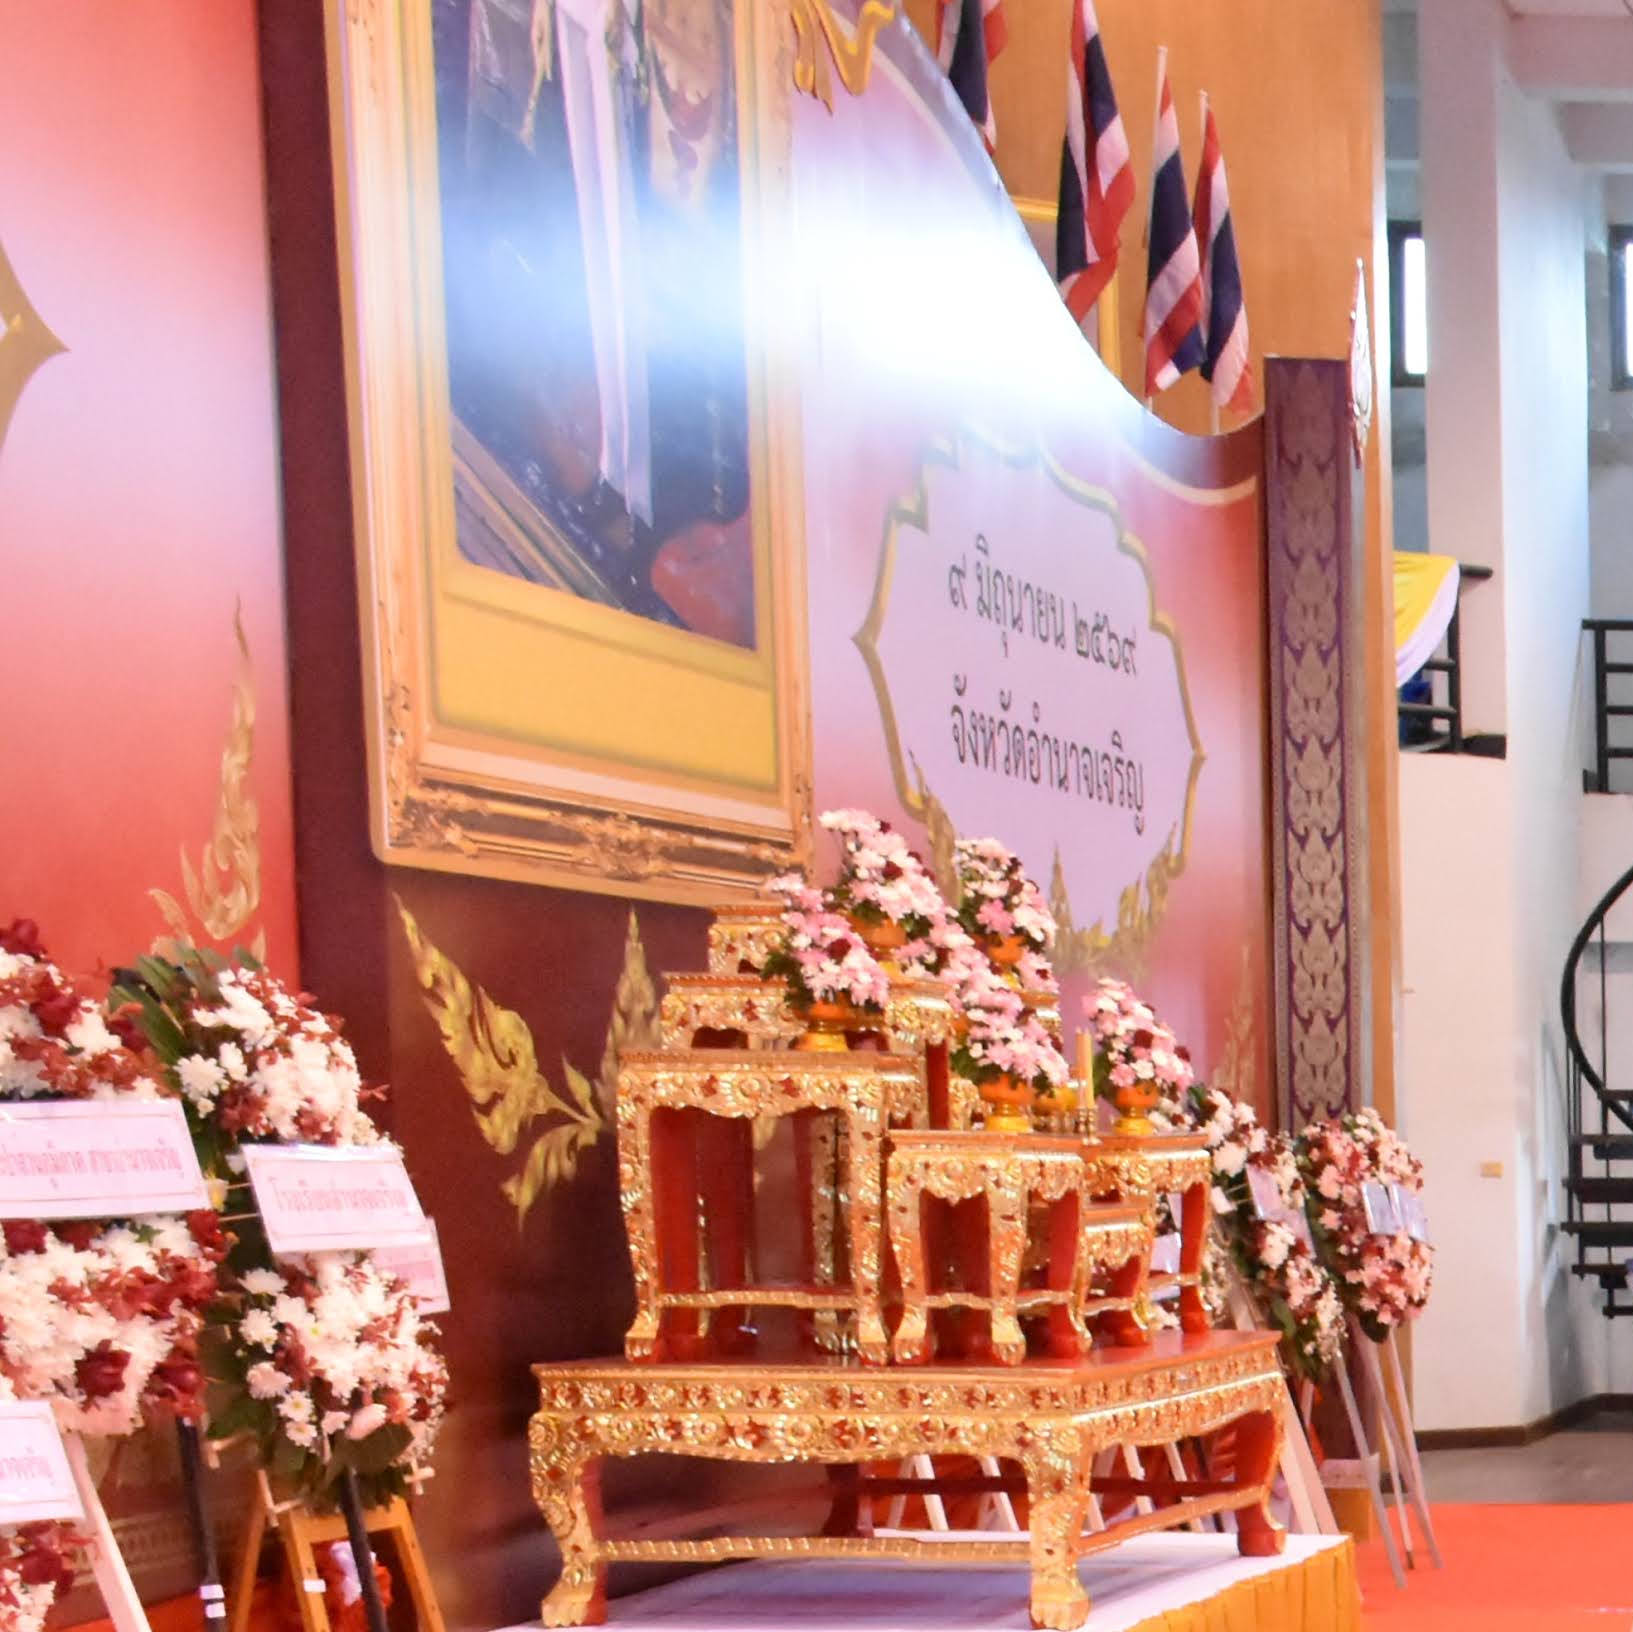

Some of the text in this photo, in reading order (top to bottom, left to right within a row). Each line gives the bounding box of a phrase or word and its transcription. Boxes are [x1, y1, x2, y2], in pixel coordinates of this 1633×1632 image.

[949, 553, 968, 611] ๙
[975, 533, 1066, 658] มิถุนายน
[950, 673, 1145, 836] จังหวัดอำนาจเจริญ
